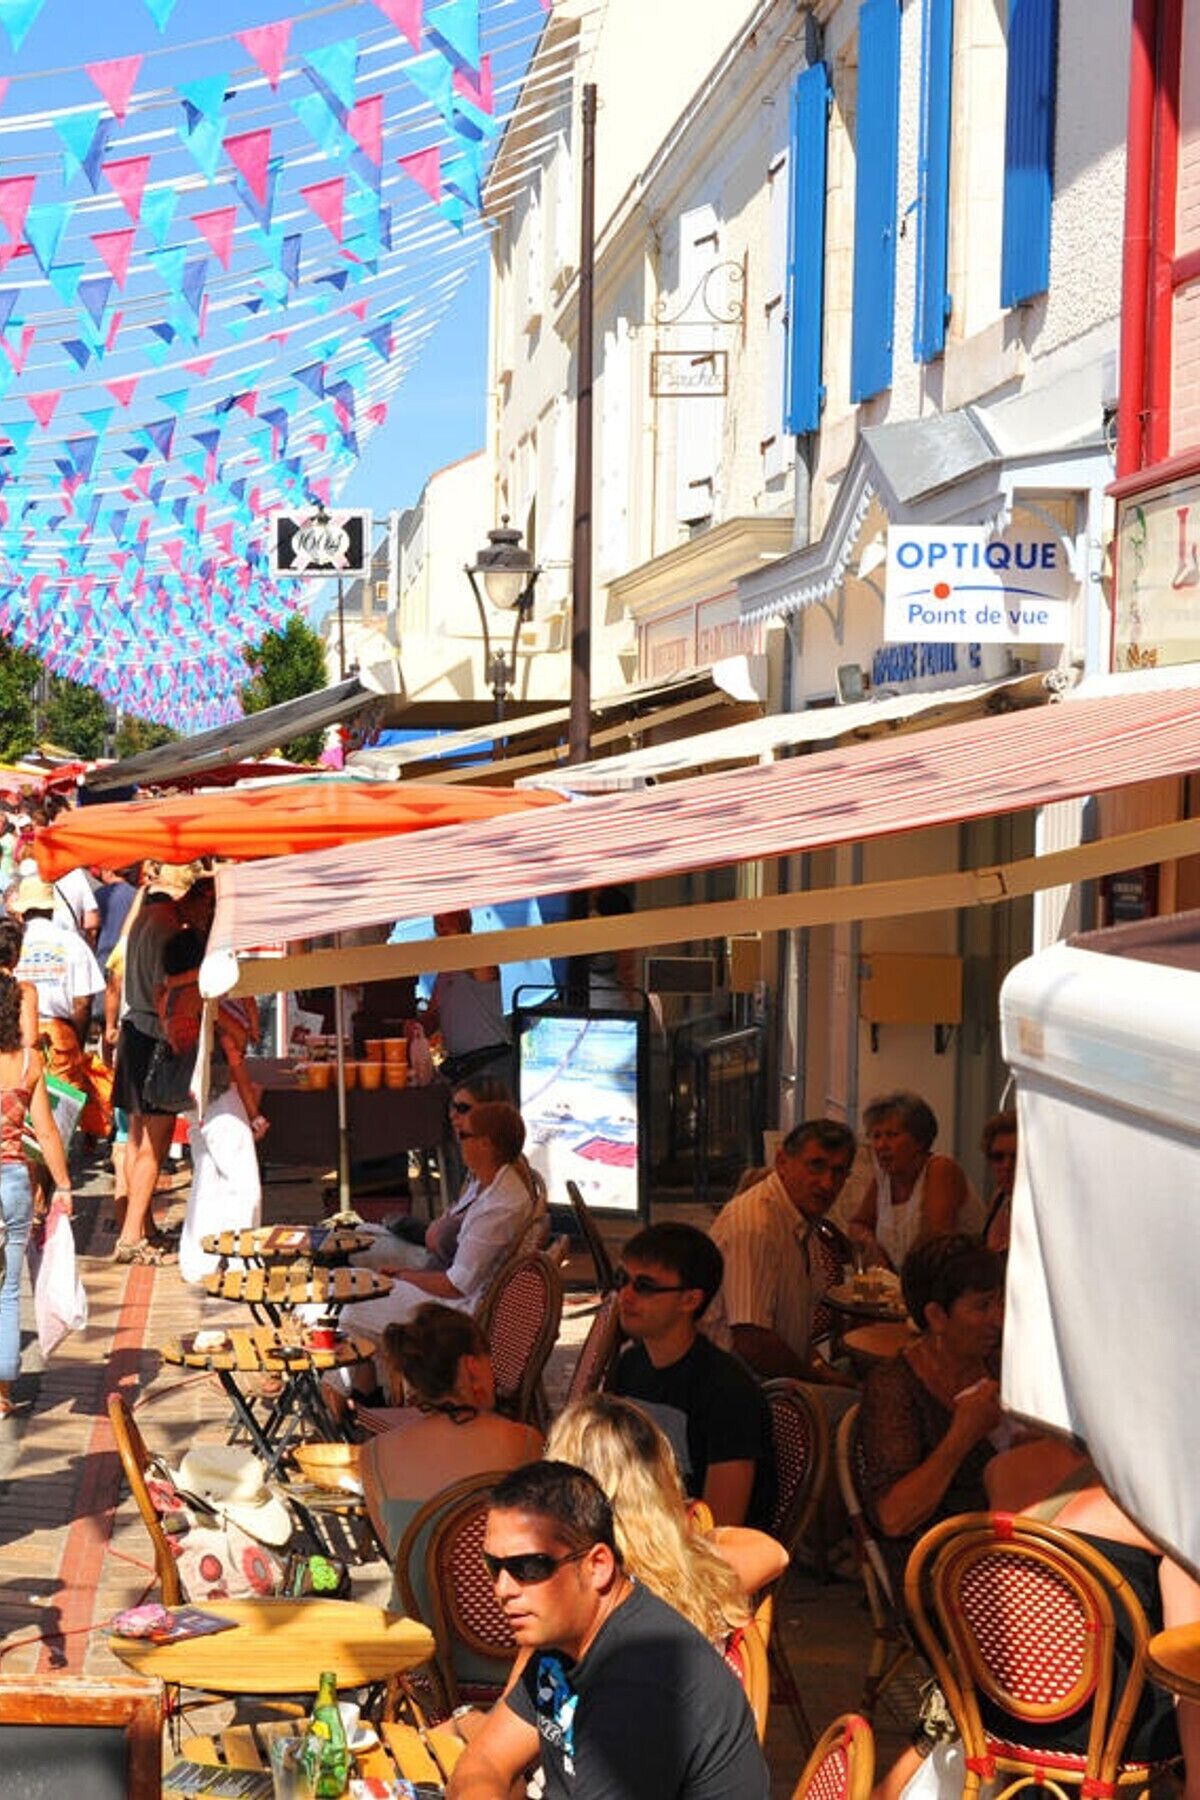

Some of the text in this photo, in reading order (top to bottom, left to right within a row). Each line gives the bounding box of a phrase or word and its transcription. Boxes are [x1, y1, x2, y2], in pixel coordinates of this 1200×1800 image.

[896, 541, 1057, 569] OPTIQUE
[908, 603, 1049, 625] Point de vue
